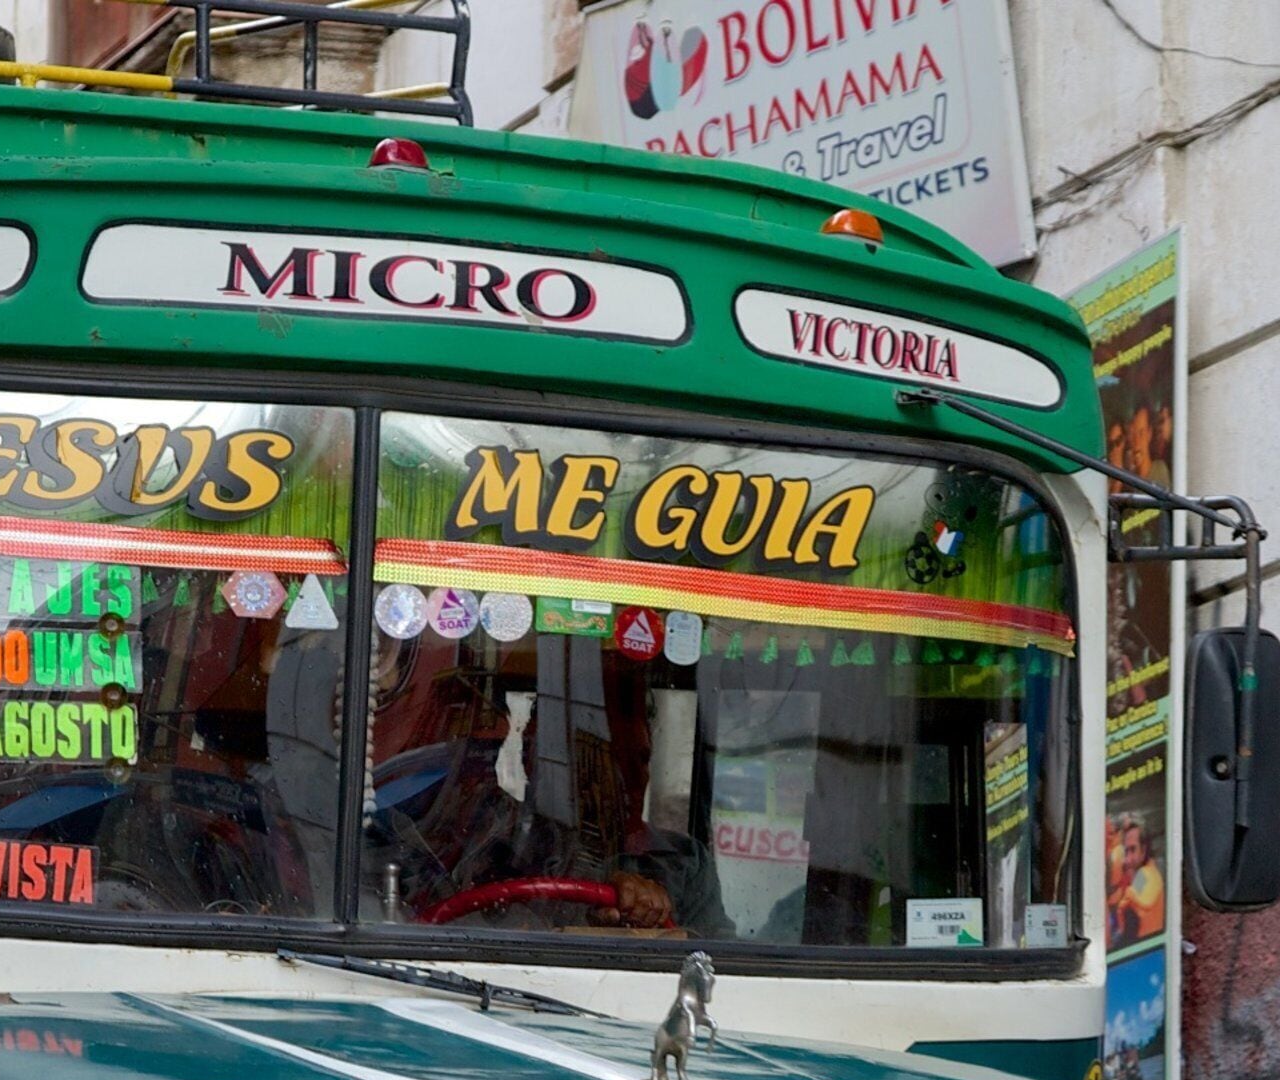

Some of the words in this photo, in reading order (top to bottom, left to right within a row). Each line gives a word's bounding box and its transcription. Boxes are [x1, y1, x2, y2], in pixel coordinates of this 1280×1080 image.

[817, 92, 948, 182] Travel
[217, 241, 598, 323] MICRO
[786, 308, 960, 383] VICTORIA
[445, 446, 621, 552] ME
[625, 465, 877, 577] GUIA
[32, 630, 137, 689] UMSA
[438, 618, 471, 632] SOAT
[622, 638, 655, 654] SOAT
